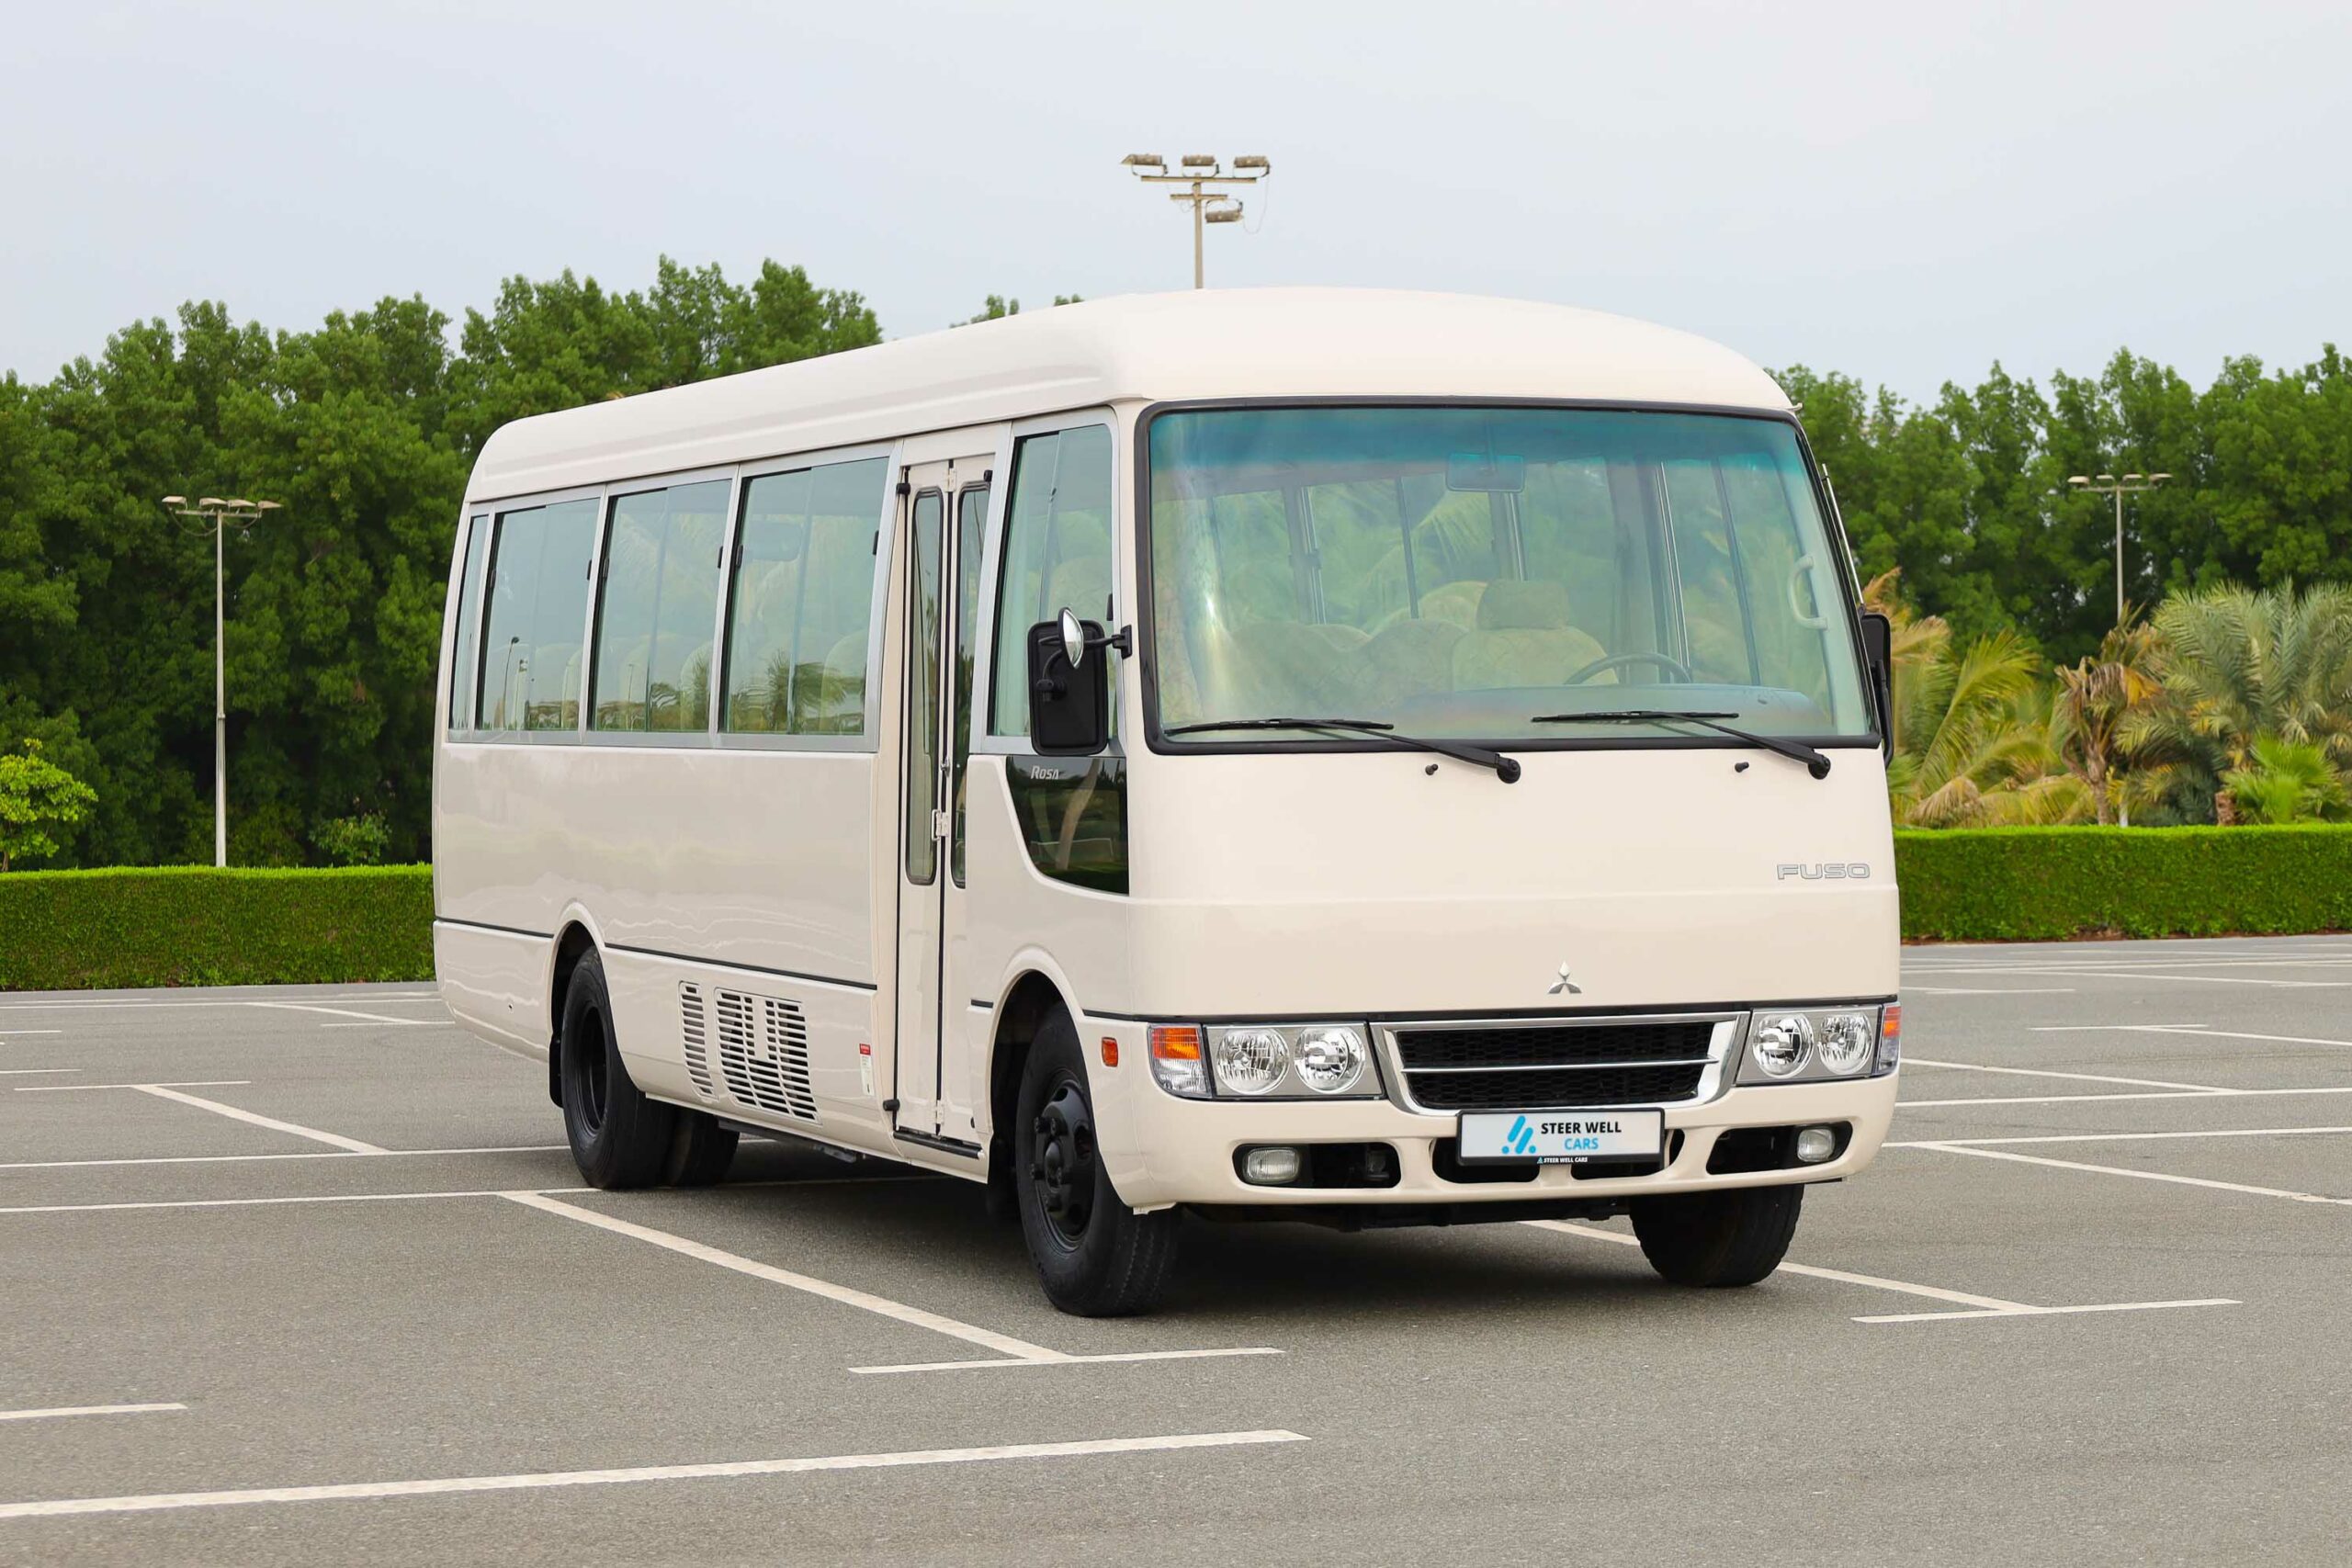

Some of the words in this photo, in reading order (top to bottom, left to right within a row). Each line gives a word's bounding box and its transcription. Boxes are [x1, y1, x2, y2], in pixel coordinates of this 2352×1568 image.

[1777, 863, 1871, 880] FUSO
[1541, 1122, 1581, 1134] STEER
[1585, 1121, 1622, 1134] WELL
[1564, 1137, 1599, 1150] CARS
